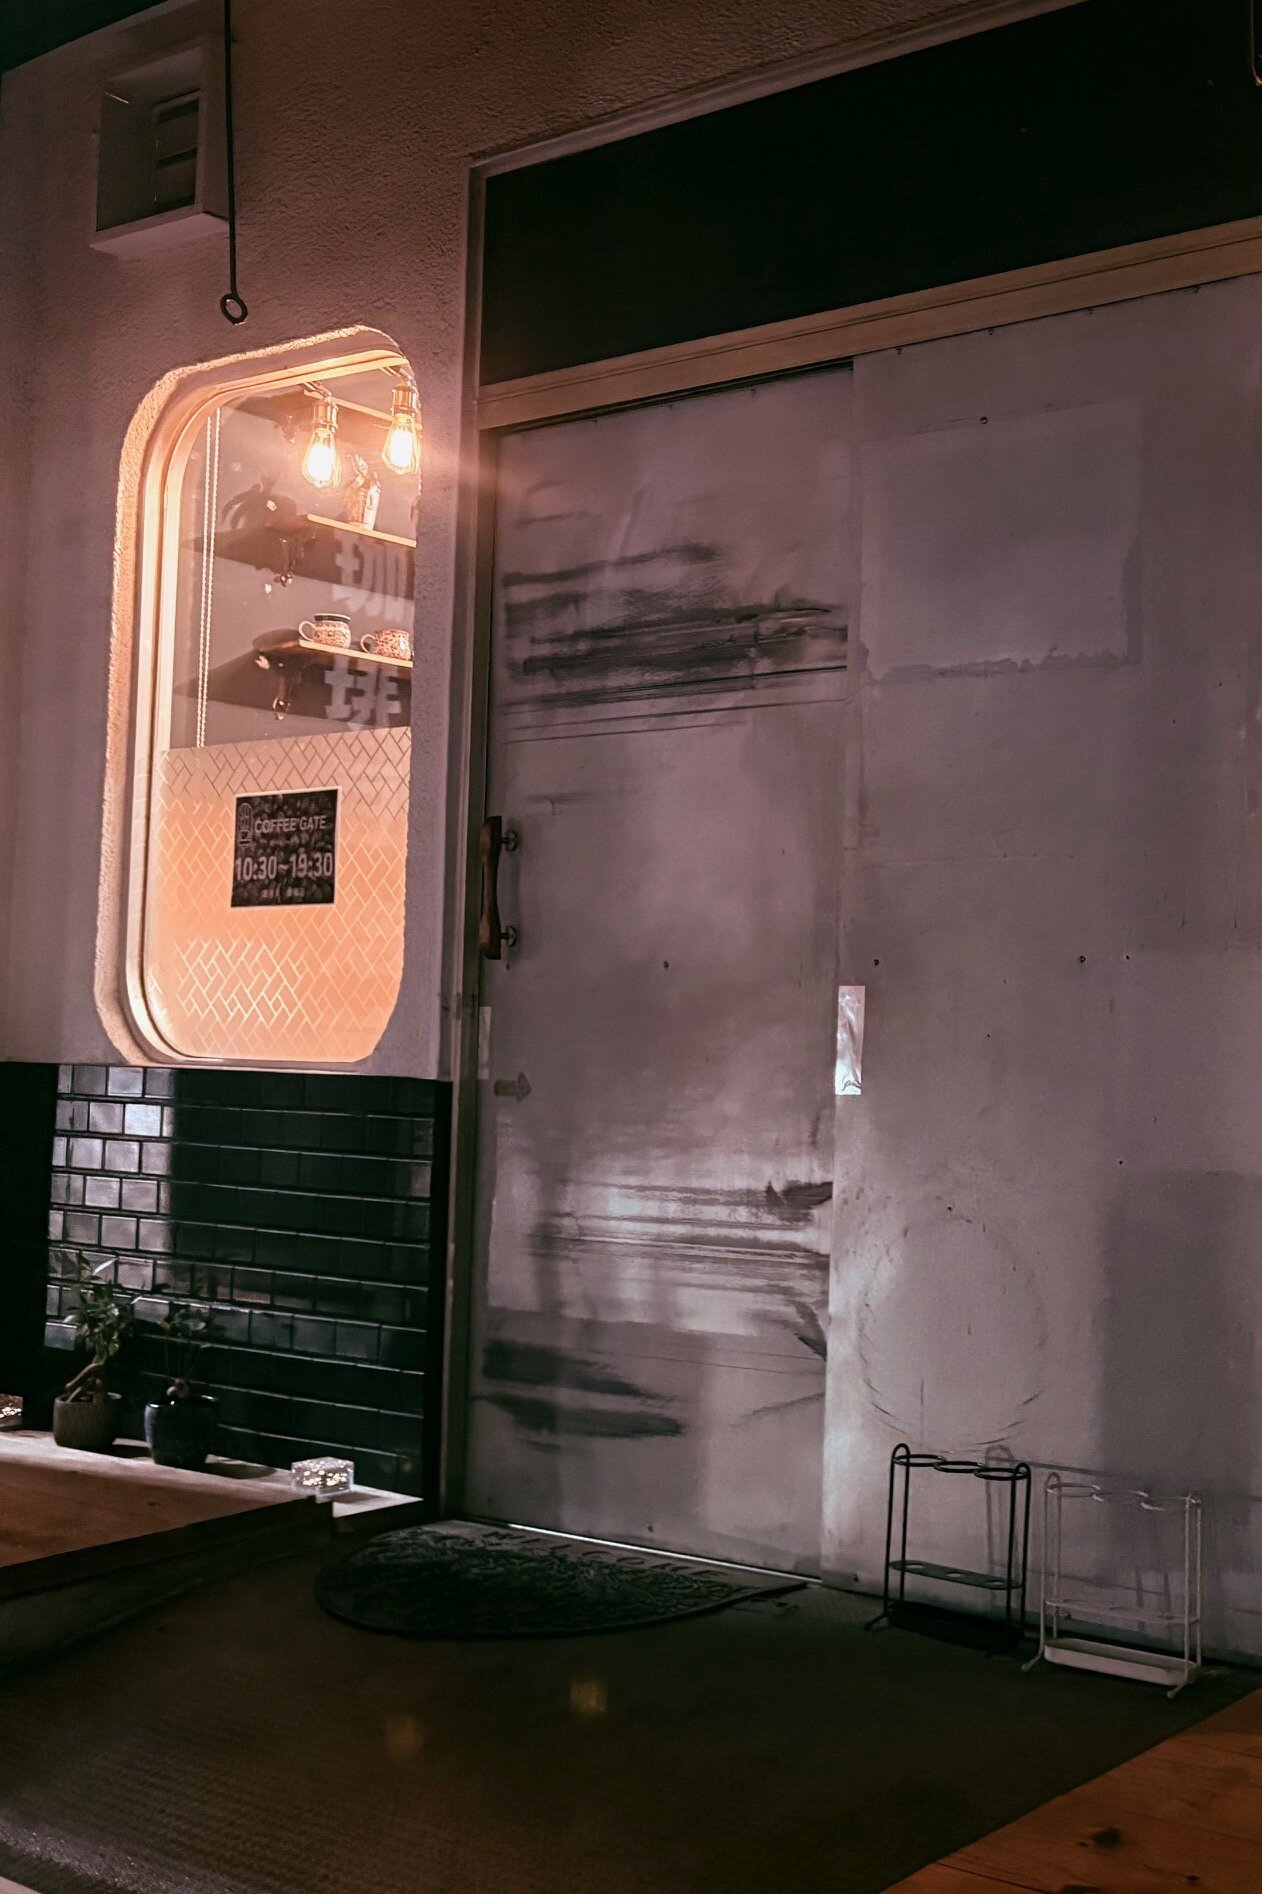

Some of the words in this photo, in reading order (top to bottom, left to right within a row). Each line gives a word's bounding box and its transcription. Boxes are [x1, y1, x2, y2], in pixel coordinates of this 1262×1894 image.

[325, 530, 408, 731] 珈琲
[254, 817, 298, 835] COFFEE
[299, 814, 328, 831] GATE
